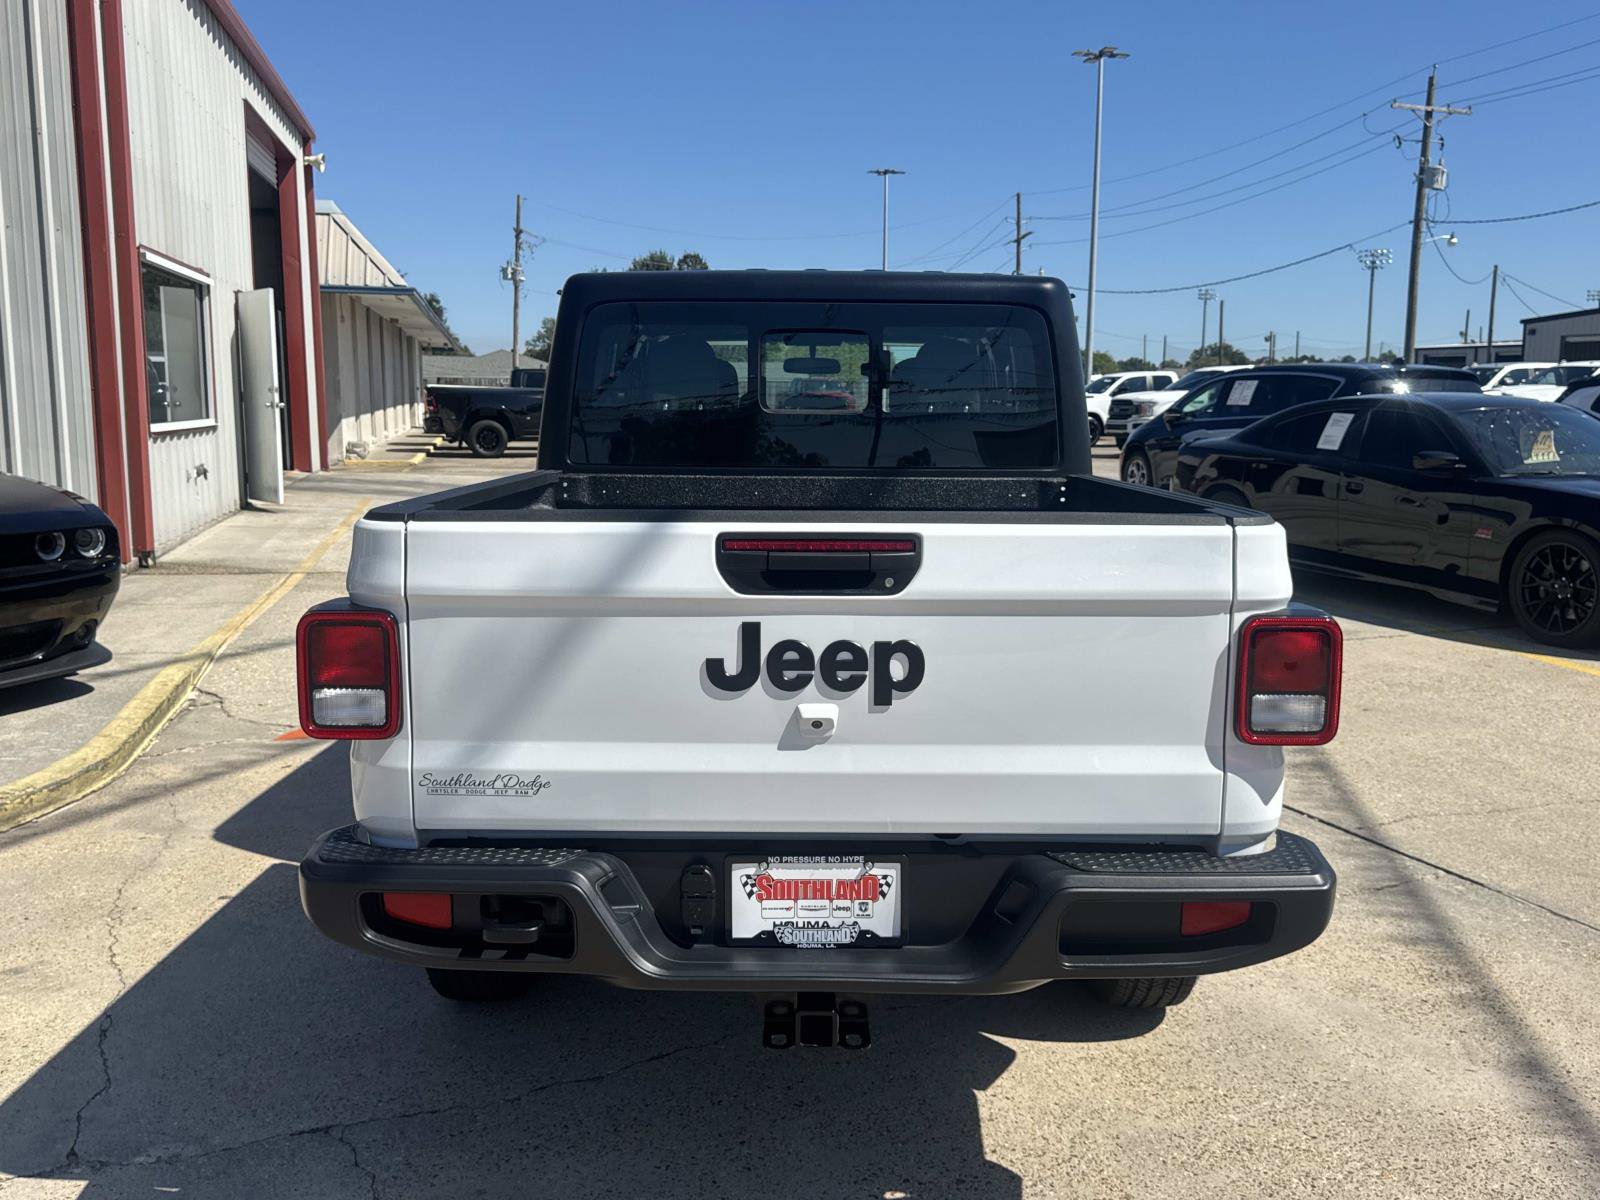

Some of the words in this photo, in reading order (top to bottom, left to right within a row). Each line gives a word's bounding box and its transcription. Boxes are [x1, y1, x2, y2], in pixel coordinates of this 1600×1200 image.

[706, 621, 925, 706] Jeep
[419, 773, 501, 789] Southland
[501, 774, 552, 796] Dodge
[755, 875, 880, 903] SOUTHLAND
[784, 928, 850, 943] SOUTHLAND
